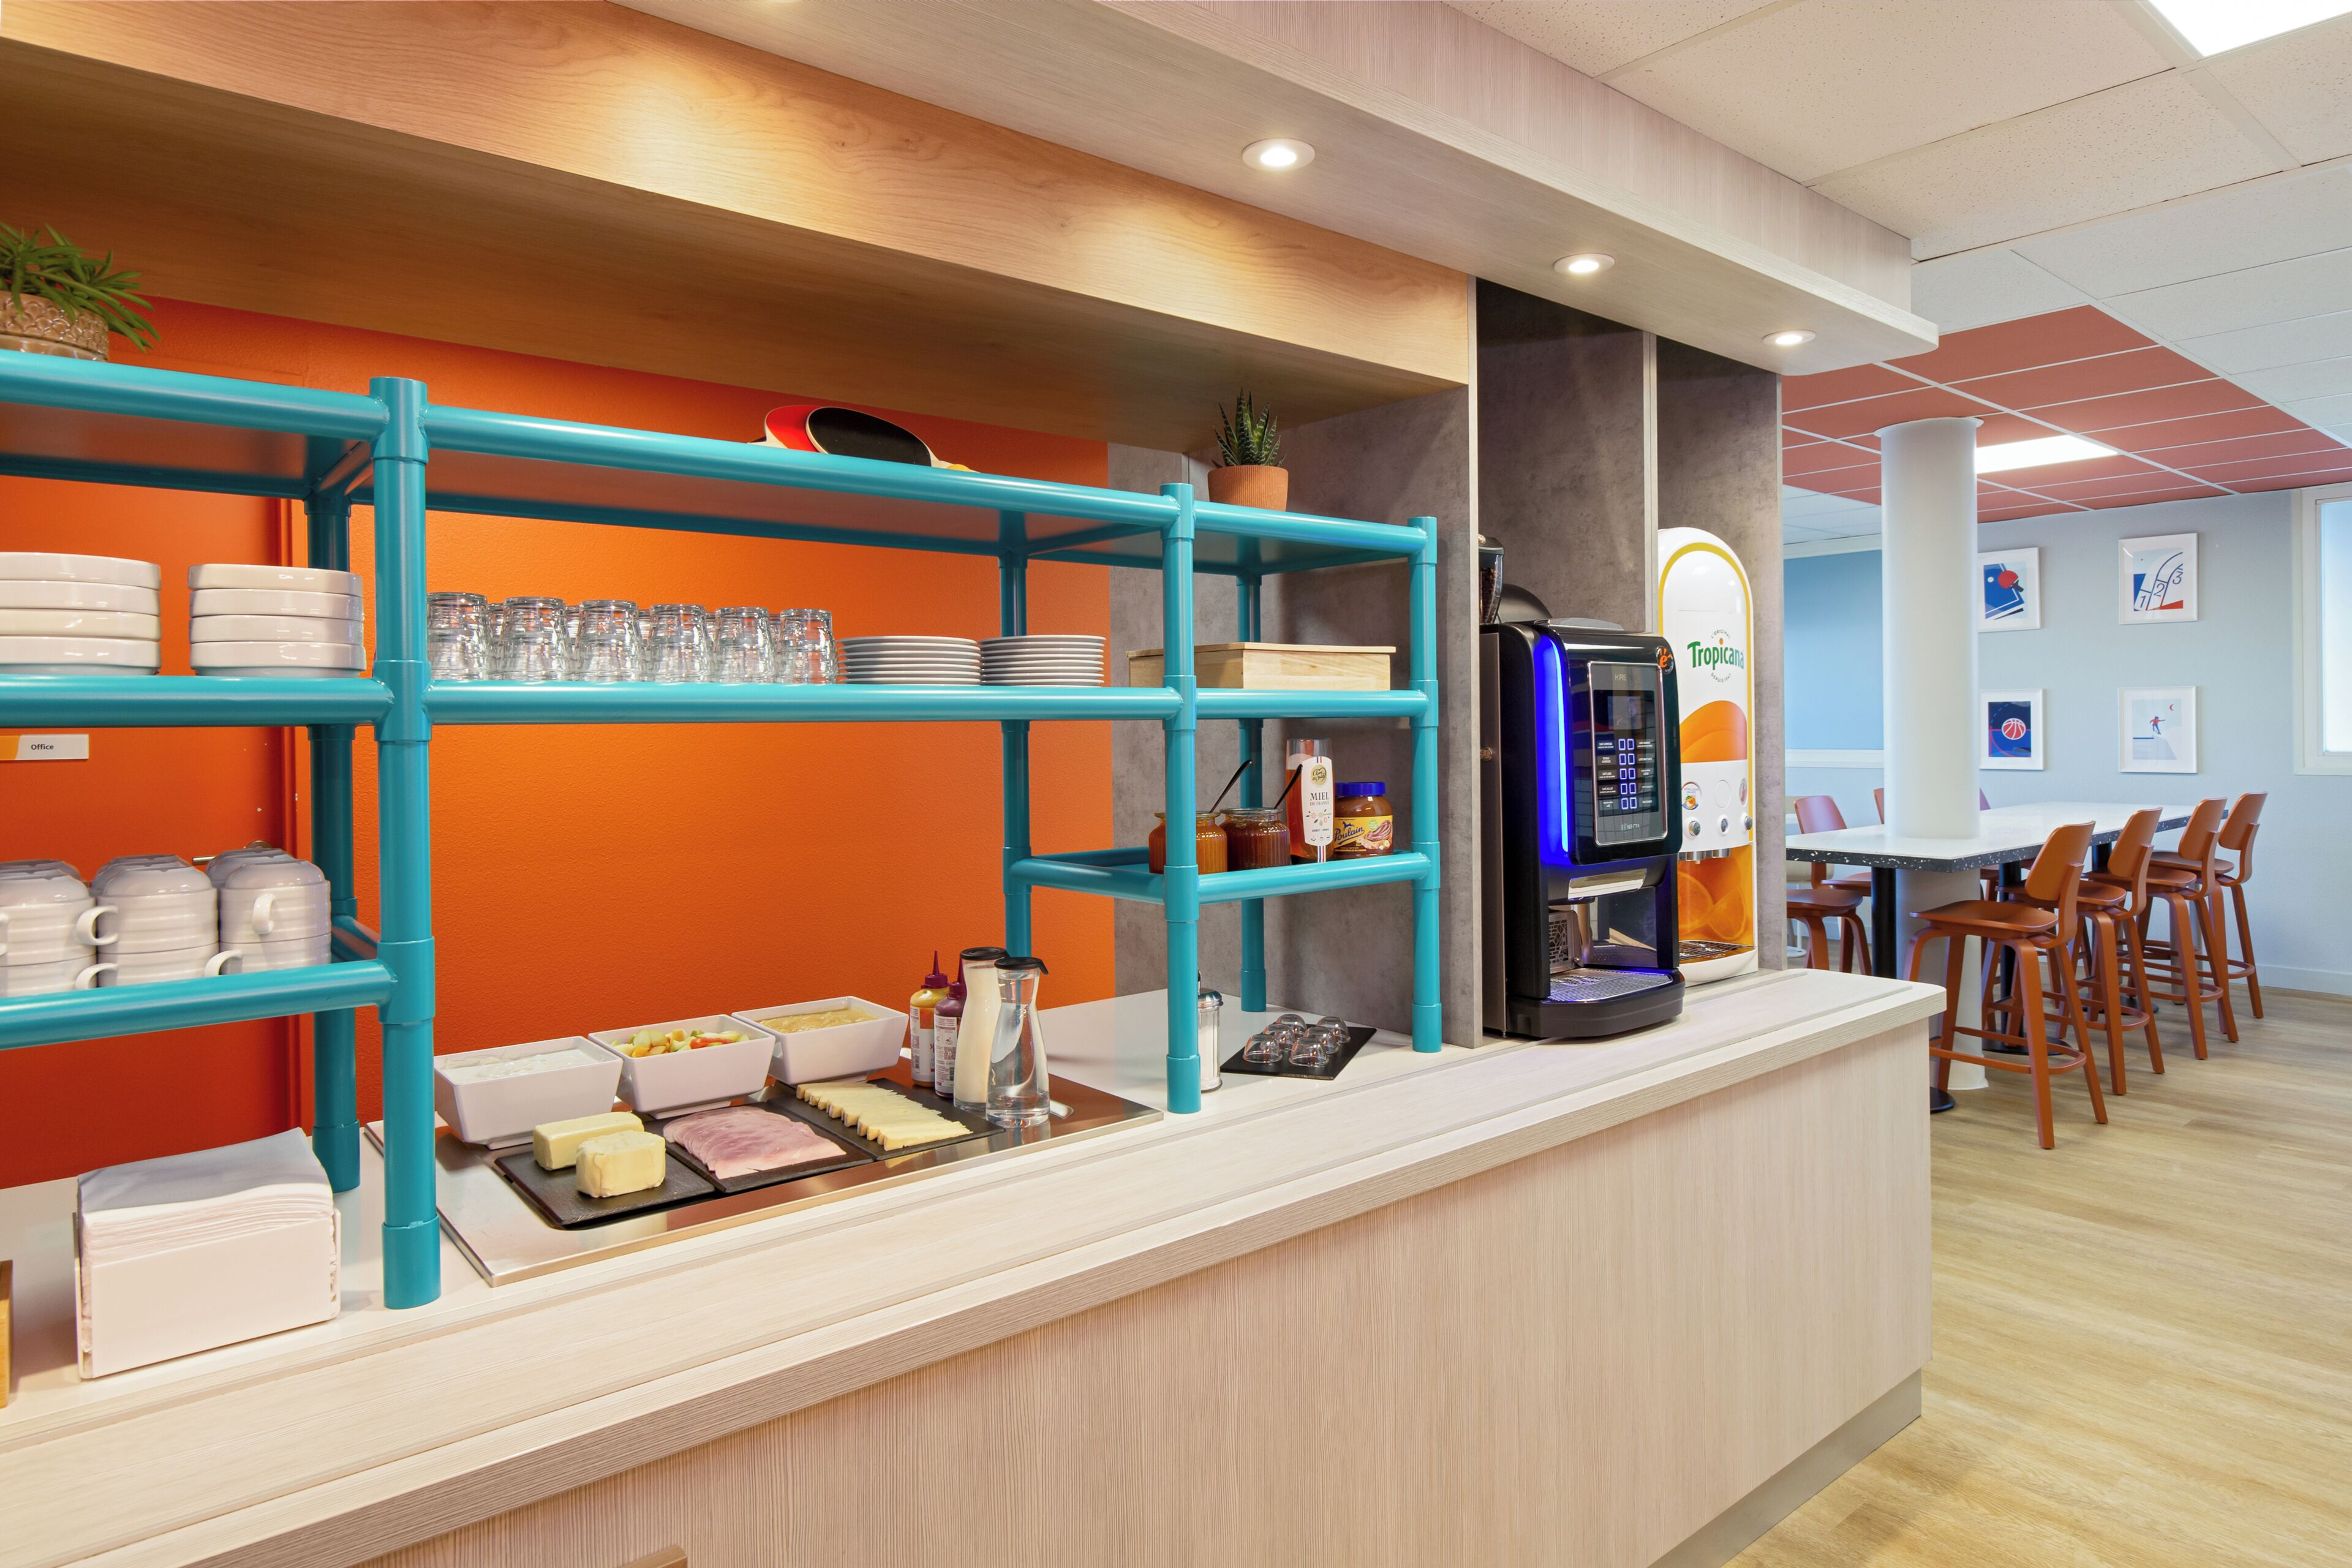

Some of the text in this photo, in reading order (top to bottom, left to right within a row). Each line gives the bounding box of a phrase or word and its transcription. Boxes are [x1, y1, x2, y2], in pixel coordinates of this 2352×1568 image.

[2153, 582, 2165, 597] 2
[1687, 638, 1744, 671] Tropicana
[1310, 791, 1329, 801] MIEL
[1333, 827, 1363, 842] Poulain
